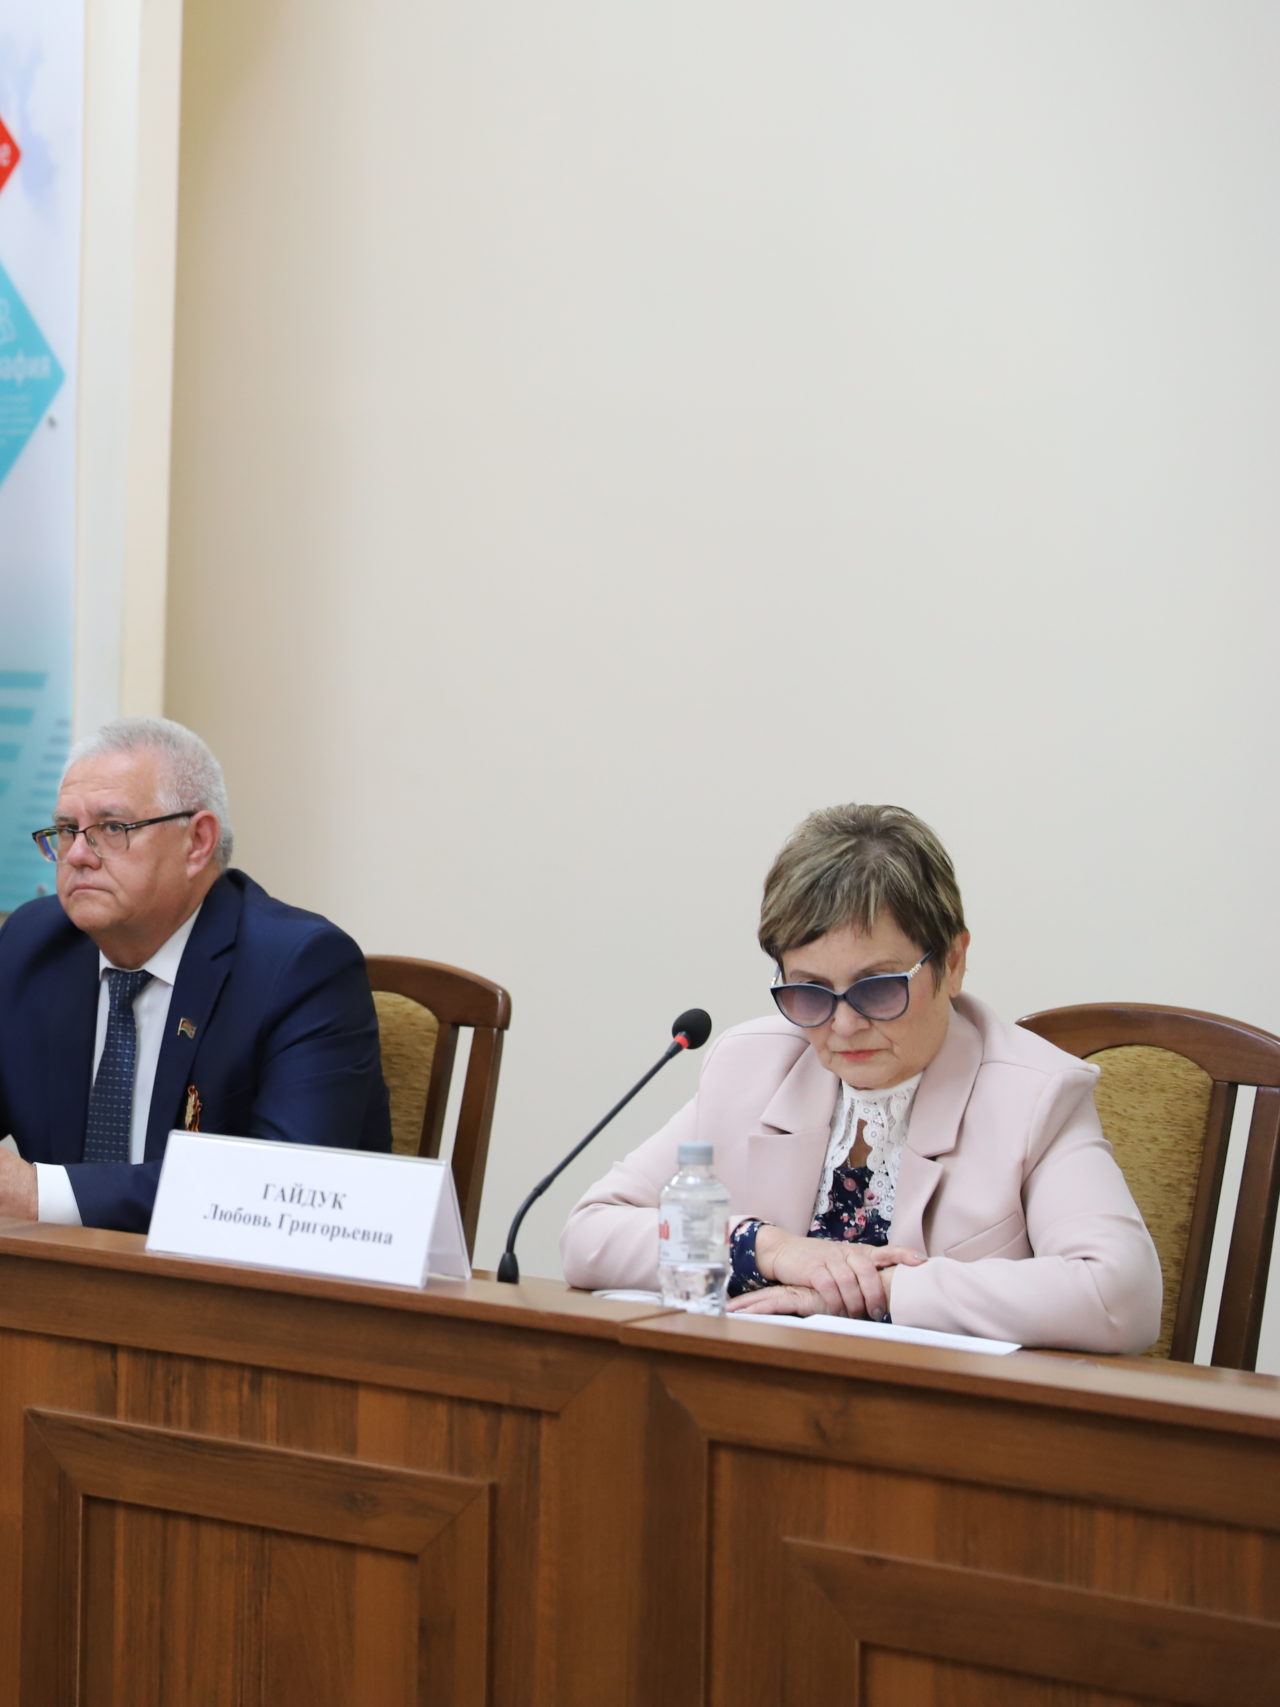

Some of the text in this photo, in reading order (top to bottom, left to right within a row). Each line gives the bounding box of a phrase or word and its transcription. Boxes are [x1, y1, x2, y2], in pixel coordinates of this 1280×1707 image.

[261, 1182, 347, 1211] ГАЙДУК
[203, 1203, 394, 1246] Любовь Григорьевна
